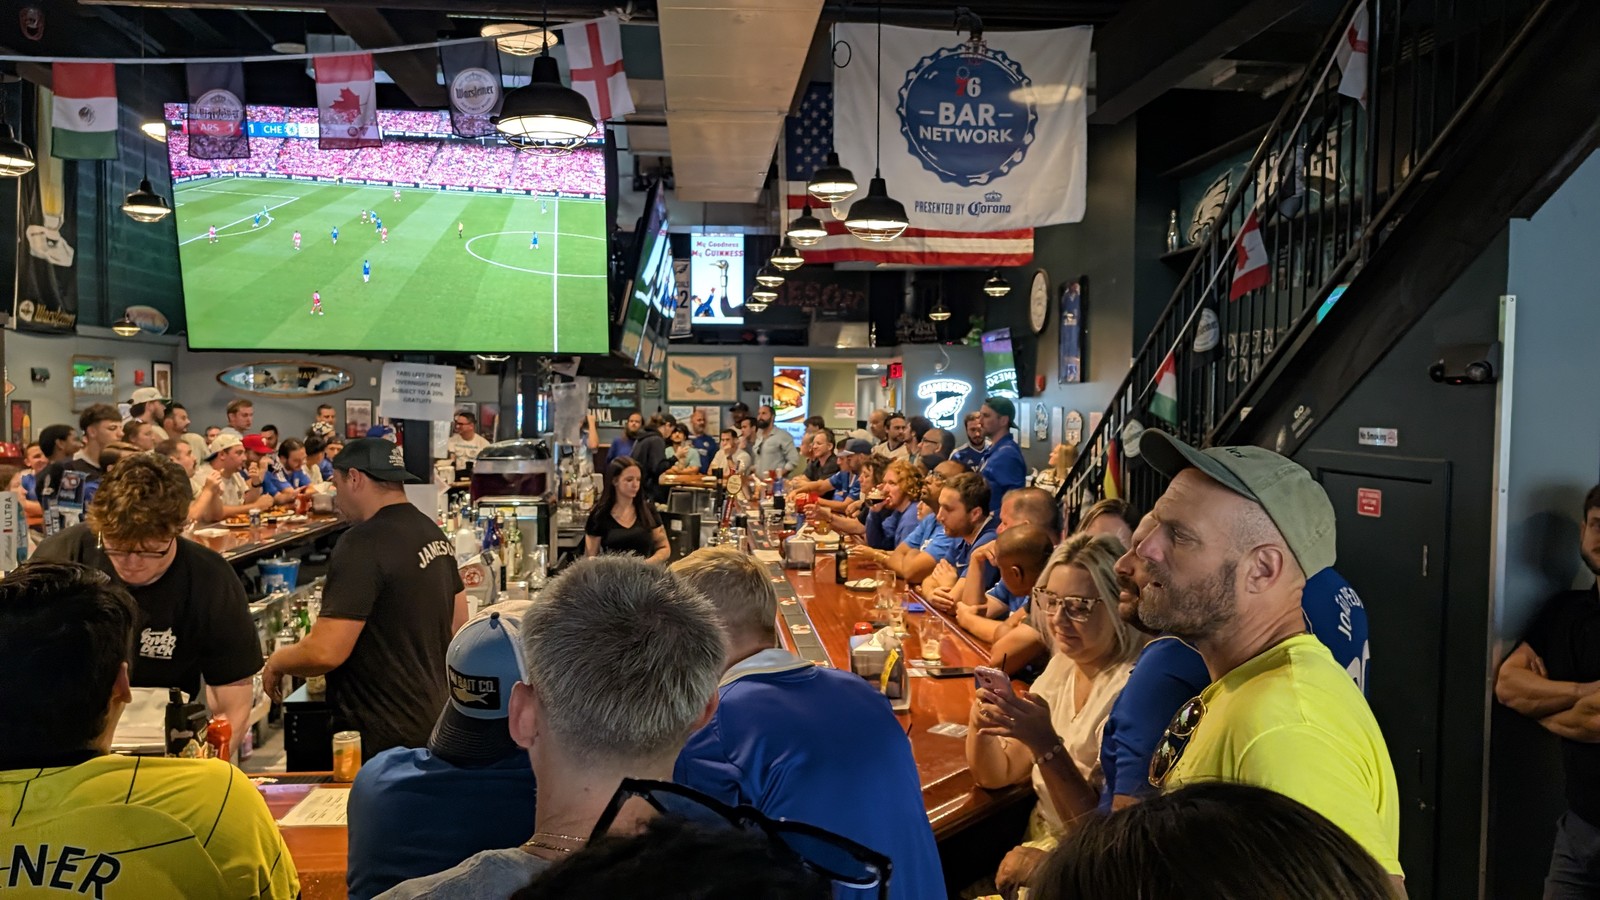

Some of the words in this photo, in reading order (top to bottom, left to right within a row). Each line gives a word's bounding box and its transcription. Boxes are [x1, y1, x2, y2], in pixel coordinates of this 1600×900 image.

[956, 77, 982, 98] 76
[938, 102, 996, 127] BAR
[200, 123, 220, 132] ARS
[248, 124, 255, 134] 1
[263, 125, 283, 135] CHE
[919, 125, 1014, 144] NETWORK
[914, 200, 954, 215] PRESENTED
[955, 203, 966, 216] BY
[967, 201, 1012, 218] Corona
[704, 248, 744, 257] GUINNESS
[708, 240, 739, 248] Goodness
[392, 387, 416, 395] SUBJECT
[1367, 431, 1387, 444] Smoking
[4, 496, 13, 528] ULTRA
[0, 843, 122, 900] NER
